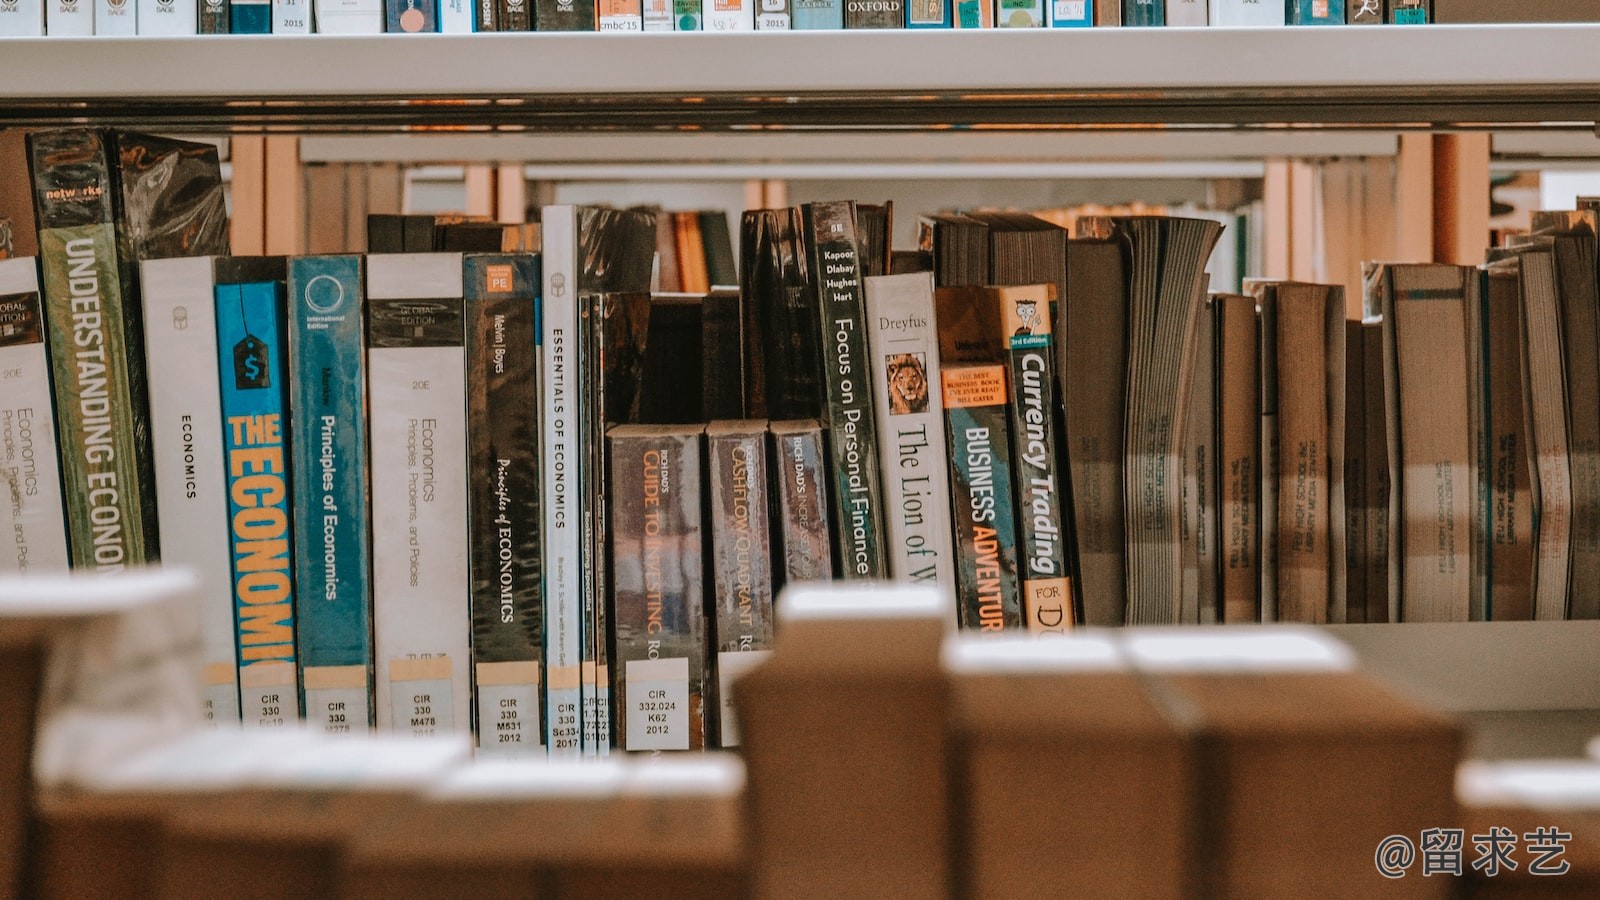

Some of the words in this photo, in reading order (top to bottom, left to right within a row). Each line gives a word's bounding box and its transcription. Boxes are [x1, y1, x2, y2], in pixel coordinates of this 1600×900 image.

[482, 0, 492, 26] OSEN
[848, 1, 899, 12] OXFORD
[284, 19, 304, 27] 2015
[766, 19, 785, 27] 2015
[46, 186, 102, 199] netwrks
[825, 250, 854, 262] Kapoor
[827, 264, 855, 275] Dlabay
[493, 278, 507, 288] PE
[827, 278, 857, 290] Hughes
[834, 292, 852, 302] Hart
[307, 315, 345, 323] International
[400, 306, 434, 315] GLOBAL
[401, 317, 436, 325] EDITION
[494, 314, 505, 343] Melvin
[879, 314, 927, 333] Dreyfus
[65, 237, 114, 464] UNDERSTANDING
[835, 318, 853, 376] Focus
[1022, 336, 1047, 345] Edition
[493, 348, 505, 374] Boyes
[3, 369, 22, 379] 20E
[553, 329, 564, 414] ESSENTIALS
[412, 380, 431, 390] 20E
[840, 380, 854, 405] on
[1021, 353, 1048, 471] Currency
[228, 414, 281, 444] THE
[554, 420, 564, 438] OF
[17, 407, 39, 496] Economics
[319, 415, 336, 493] Principles
[793, 436, 803, 462] RICH
[843, 408, 869, 493] Personal
[898, 423, 930, 469] The
[181, 415, 196, 499] ECONOMICS
[423, 418, 437, 502] Economics
[660, 449, 669, 470] RICH
[495, 458, 511, 512] Principles
[643, 450, 660, 507] GUIDE
[661, 470, 670, 493] DAD'S
[795, 463, 806, 494] DAD'S
[965, 427, 996, 523] BUSINESS
[555, 444, 565, 529] ECONOMICS
[731, 446, 750, 534] CASHFLOW
[323, 496, 337, 511] of
[900, 474, 932, 526] Lion
[495, 513, 511, 525] of
[644, 512, 661, 536] TO
[797, 495, 810, 547] INCREASE
[1030, 474, 1059, 575] Trading
[14, 524, 26, 547] and
[409, 526, 420, 547] and
[851, 498, 869, 575] Finance
[229, 446, 296, 663] ECONOMI
[905, 535, 938, 558] of
[324, 514, 338, 600] Economics
[410, 549, 421, 587] Policies
[499, 527, 514, 623] ECONOMICS
[645, 539, 662, 635] INVESTING
[735, 537, 753, 626] QUADRANT
[1036, 586, 1061, 598] FOR
[261, 694, 279, 705] CIR
[413, 694, 431, 705] CIR
[500, 698, 517, 708] CIR
[648, 689, 665, 699] CIR
[262, 707, 279, 717] 330
[328, 702, 345, 712] CIR
[414, 706, 431, 716] 330
[501, 710, 517, 720] 330
[557, 703, 575, 713] CIR
[639, 702, 675, 711] 332.024
[329, 714, 345, 724] 330
[411, 717, 436, 727] M478
[497, 722, 521, 731] M531
[559, 715, 575, 725] 330
[648, 713, 667, 723] K62
[499, 733, 521, 743] 2012
[646, 725, 668, 734] 2012
[557, 740, 577, 749] 2017
